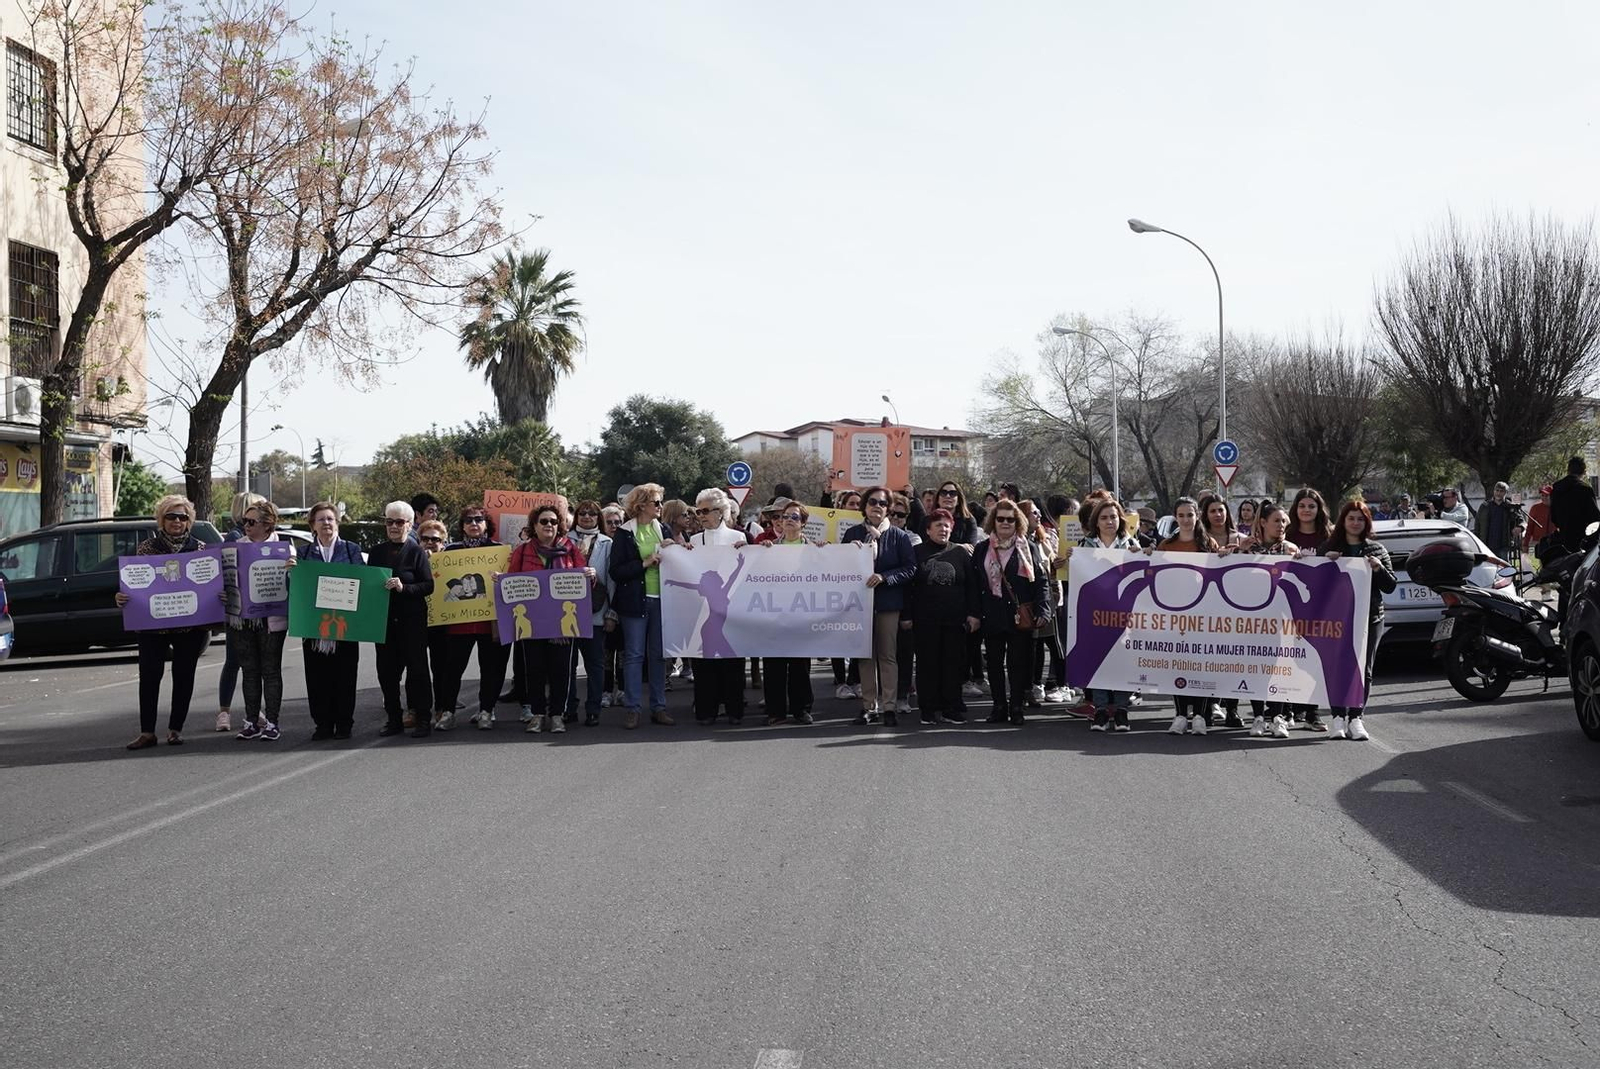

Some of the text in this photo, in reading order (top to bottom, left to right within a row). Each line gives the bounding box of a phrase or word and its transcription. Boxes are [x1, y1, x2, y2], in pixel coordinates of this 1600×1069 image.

[443, 553, 499, 568] QUEREMOS
[745, 573, 863, 584] Asociación de Mujeres
[746, 590, 864, 613] AL ALBA
[440, 608, 492, 622] SIN MIEDO
[811, 621, 864, 632] CÓRDOBA
[1092, 609, 1344, 640] SURESTE SE PONE LAS GAFAS VIOLETAS
[1125, 639, 1307, 659] 8 DE MARZO DÍA DE LA MUJER TRABAJADORA
[1138, 657, 1292, 676] Escuela Pública Educando en Valores
